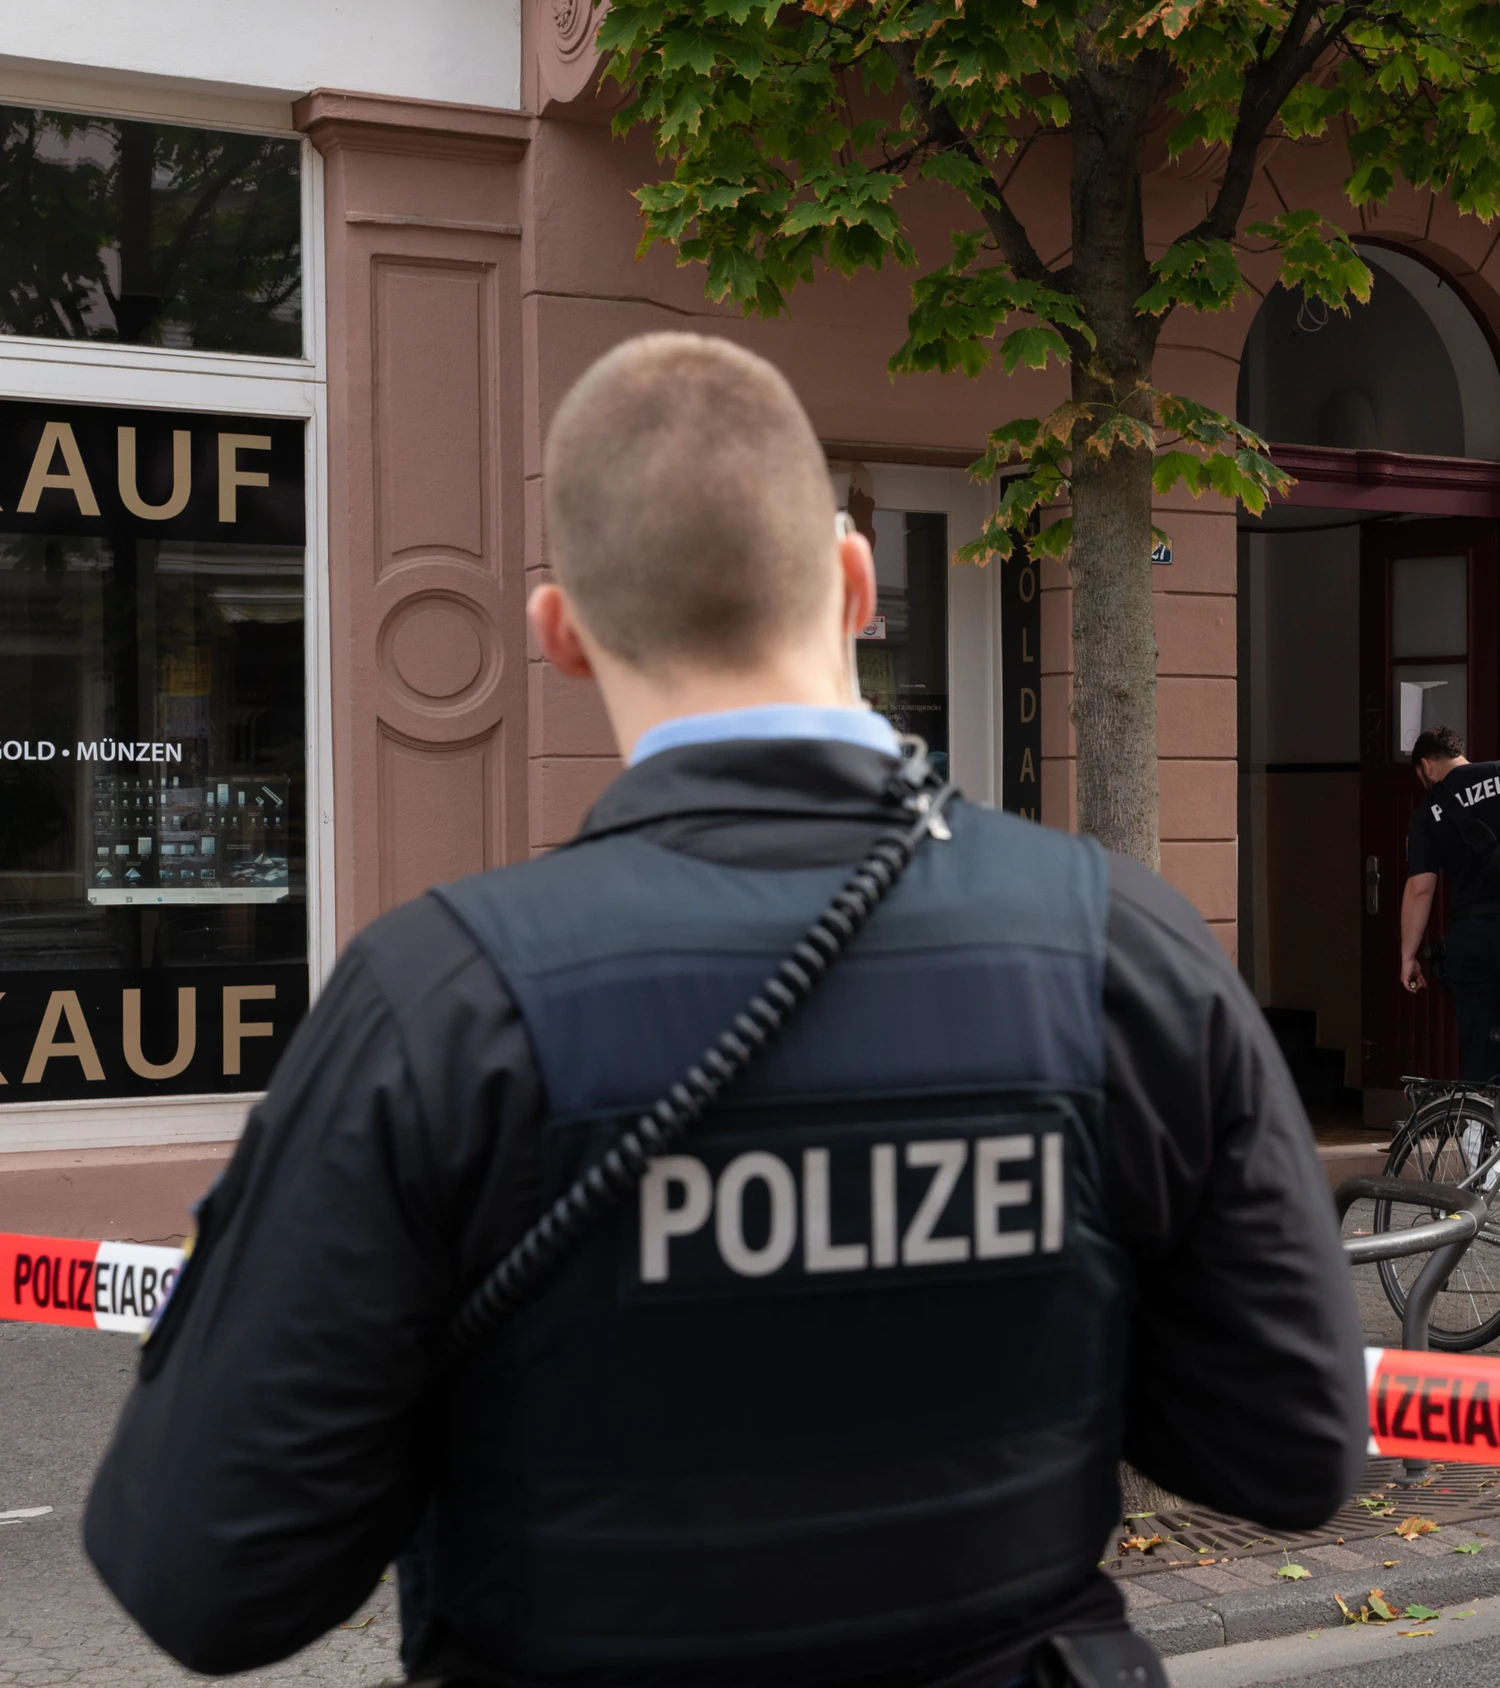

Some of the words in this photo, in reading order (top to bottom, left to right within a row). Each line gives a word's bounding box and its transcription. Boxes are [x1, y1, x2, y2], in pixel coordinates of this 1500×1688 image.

[0, 421, 272, 524] AUF
[0, 740, 56, 761] OLD
[77, 738, 182, 762] MÜNZEN
[0, 984, 277, 1085] AUF
[639, 1132, 1065, 1285] POLIZEI
